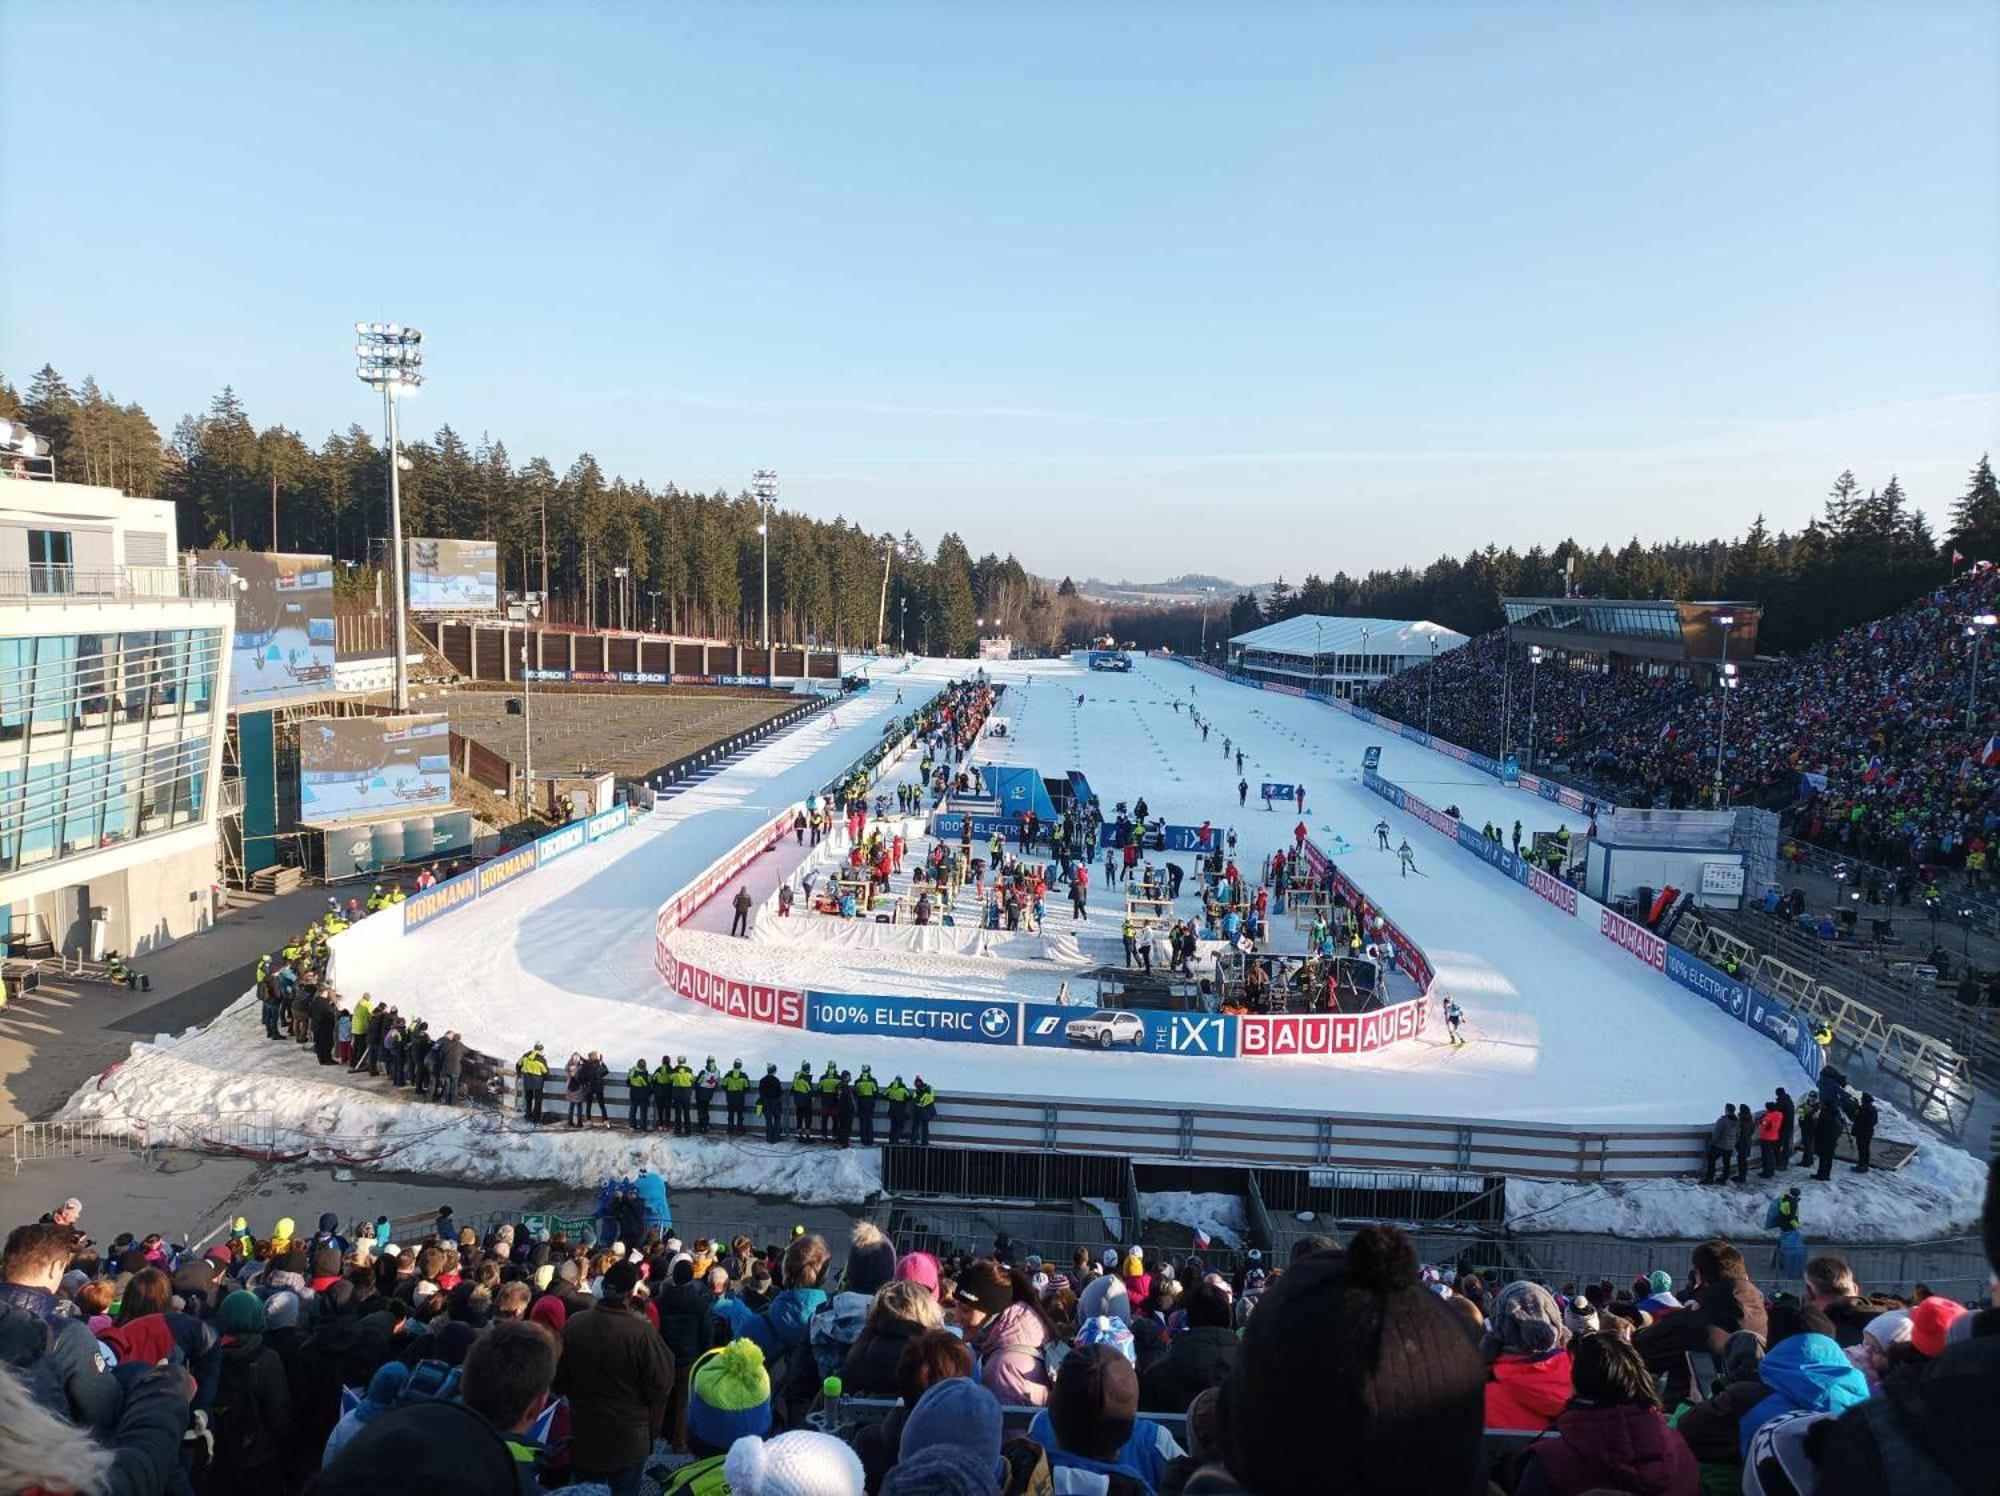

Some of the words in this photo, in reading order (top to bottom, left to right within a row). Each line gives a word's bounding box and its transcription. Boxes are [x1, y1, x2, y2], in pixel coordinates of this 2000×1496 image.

[1529, 869, 1576, 914] BAUHAUS
[1602, 912, 1664, 967] BAUHAUS
[671, 958, 802, 1022] BAUHAUS
[1688, 966, 1729, 1003] ELECTRIC
[813, 1005, 869, 1025] 100%
[874, 1008, 974, 1030] ELECTRIC
[1155, 1025, 1168, 1049] THE
[1170, 1016, 1225, 1053] iX1
[1244, 1006, 1413, 1050] BAUHAUS
